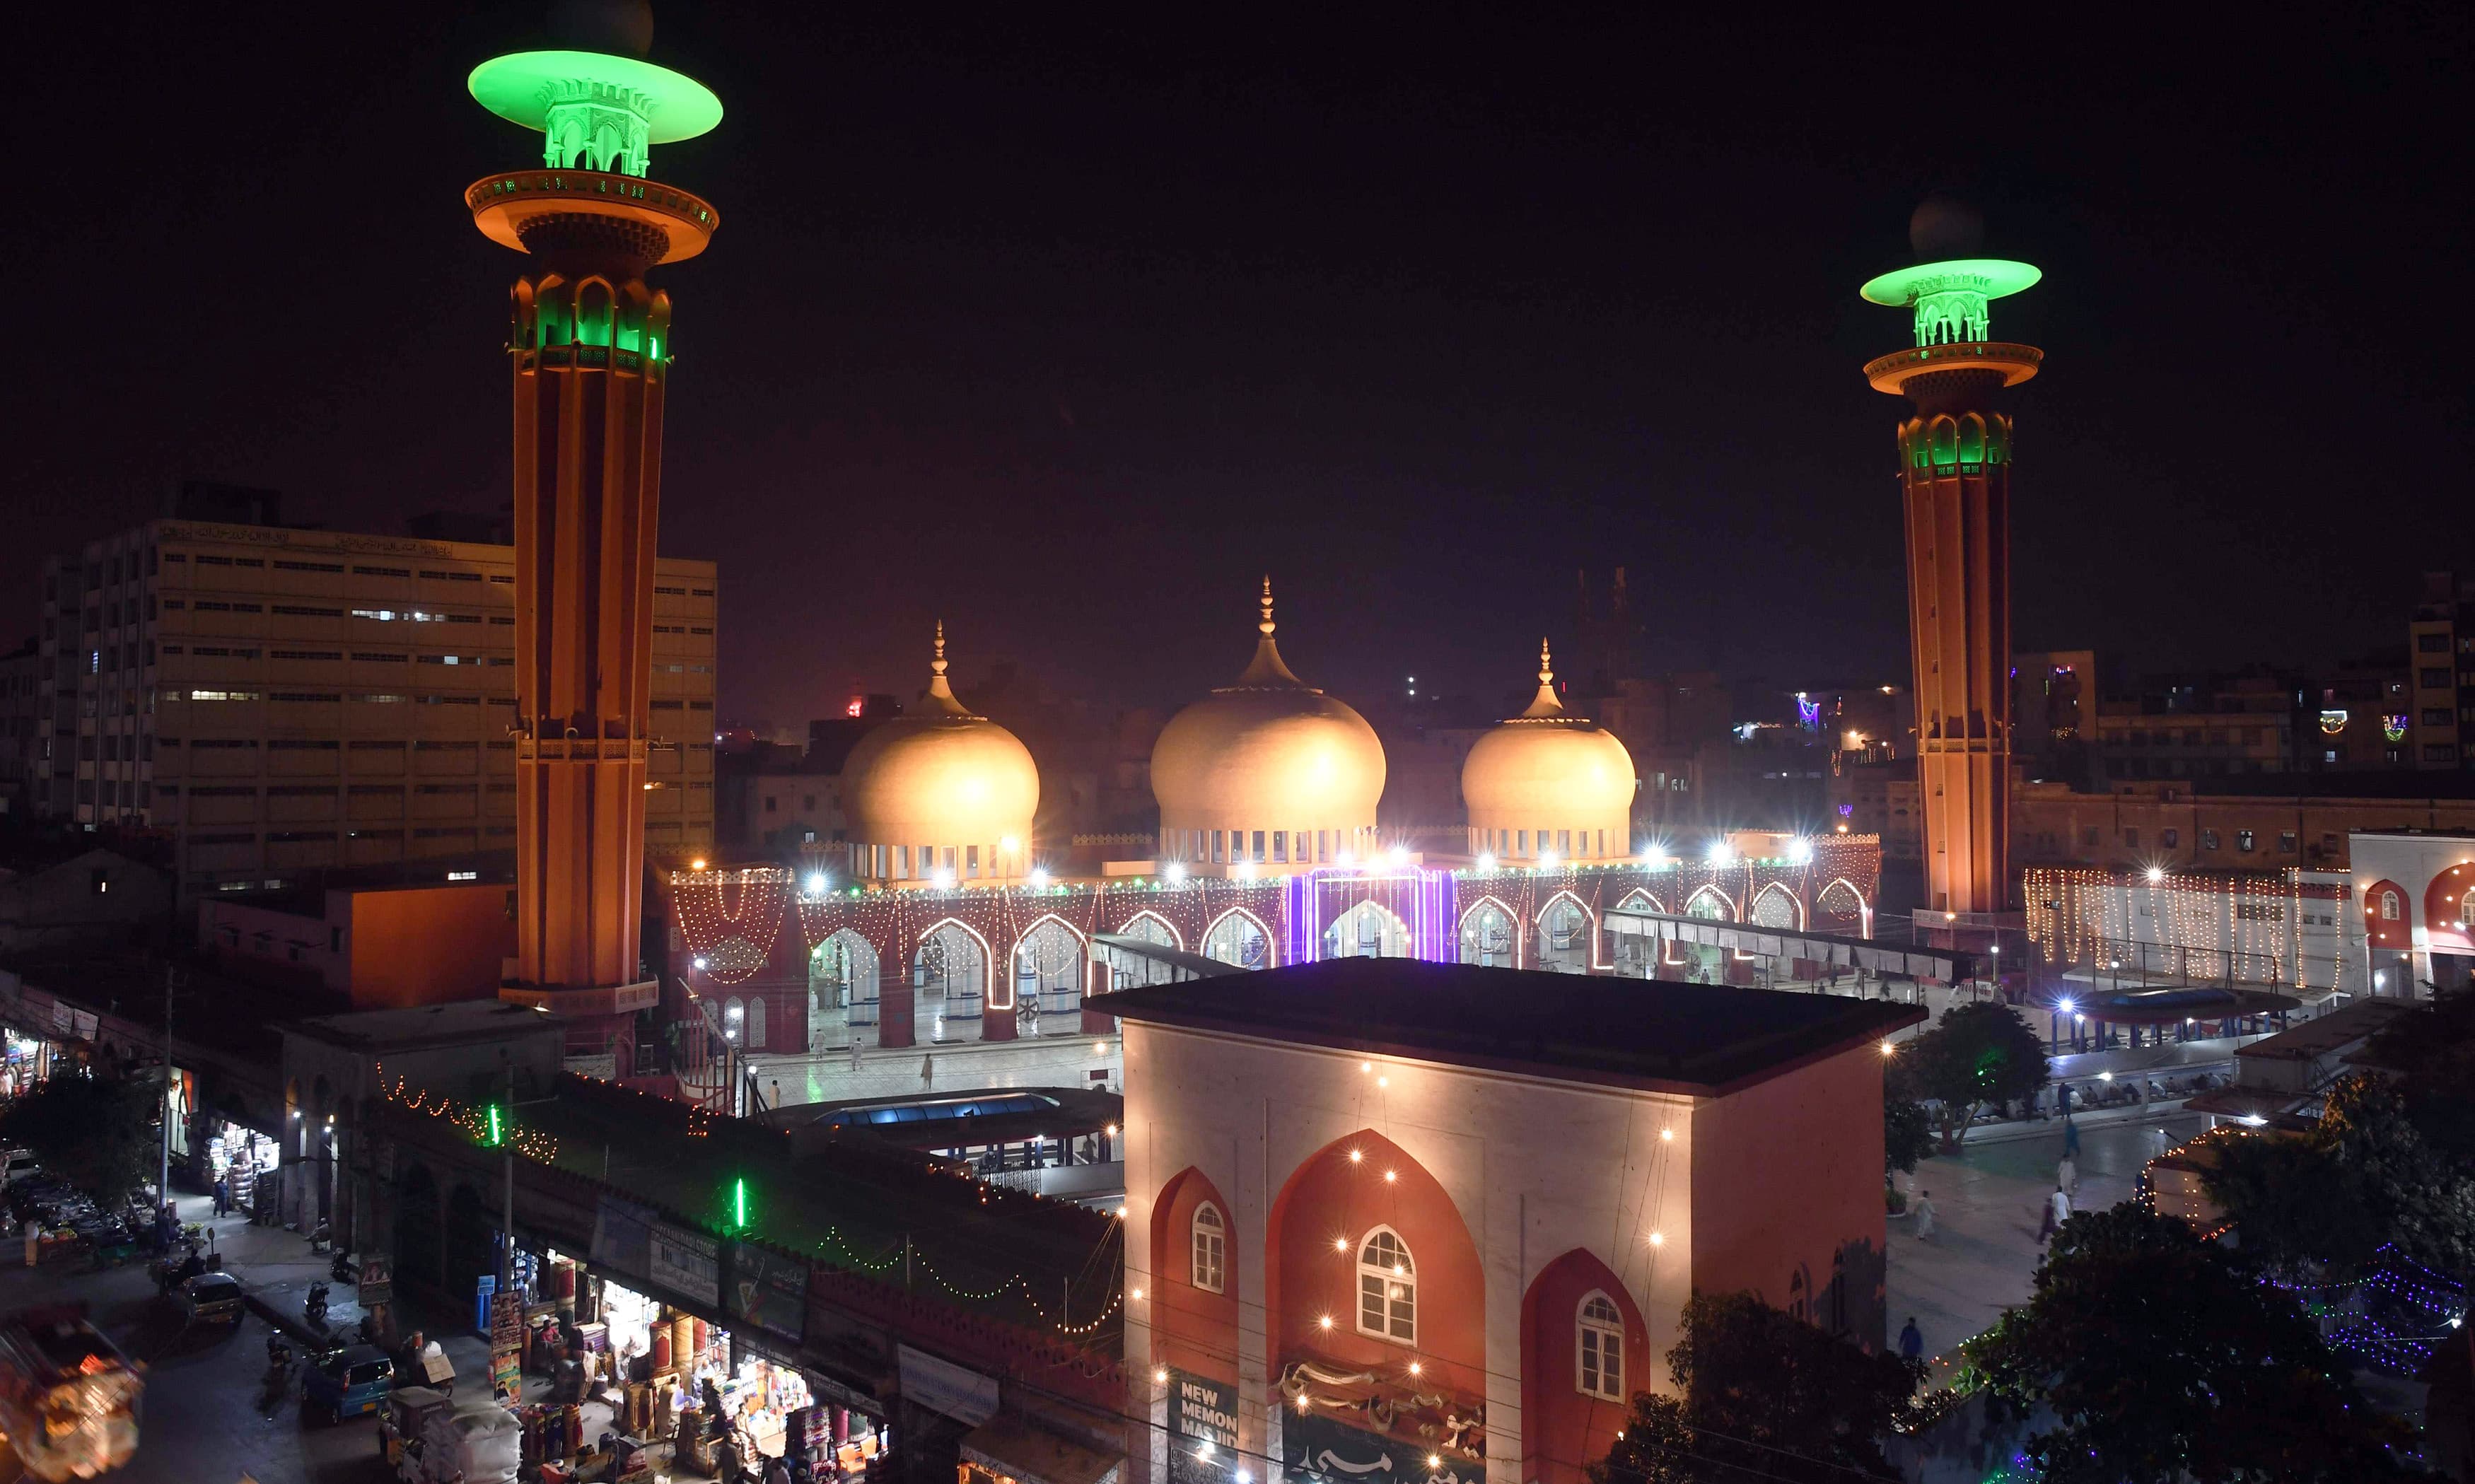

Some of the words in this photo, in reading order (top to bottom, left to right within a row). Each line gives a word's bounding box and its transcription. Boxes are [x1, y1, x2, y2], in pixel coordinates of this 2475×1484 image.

[1181, 1381, 1218, 1407] NEW
[1182, 1399, 1238, 1432] MEMON
[1181, 1418, 1238, 1448] MASJID
